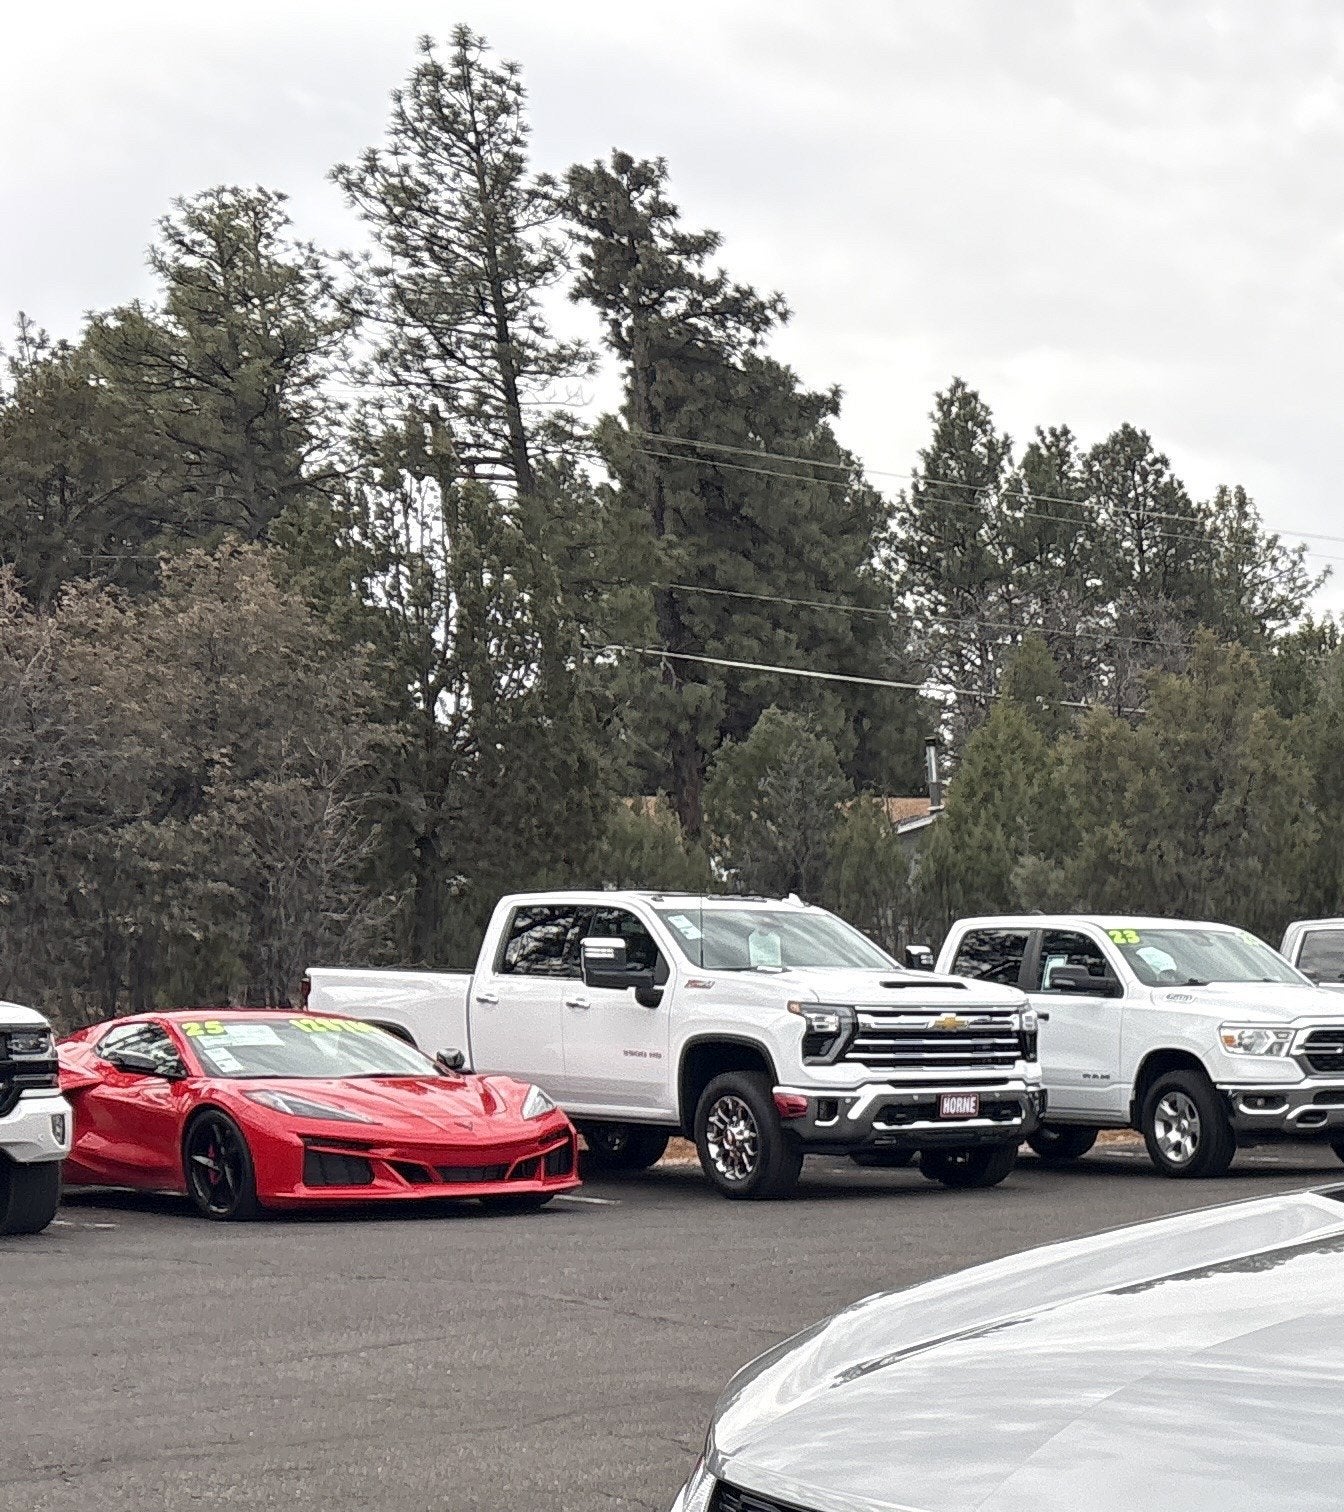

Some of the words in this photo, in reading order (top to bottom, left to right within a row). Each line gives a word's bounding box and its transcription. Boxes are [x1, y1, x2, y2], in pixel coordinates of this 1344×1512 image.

[1108, 929, 1141, 945] 23
[181, 1020, 225, 1037] 25
[942, 1096, 977, 1115] HORNE
